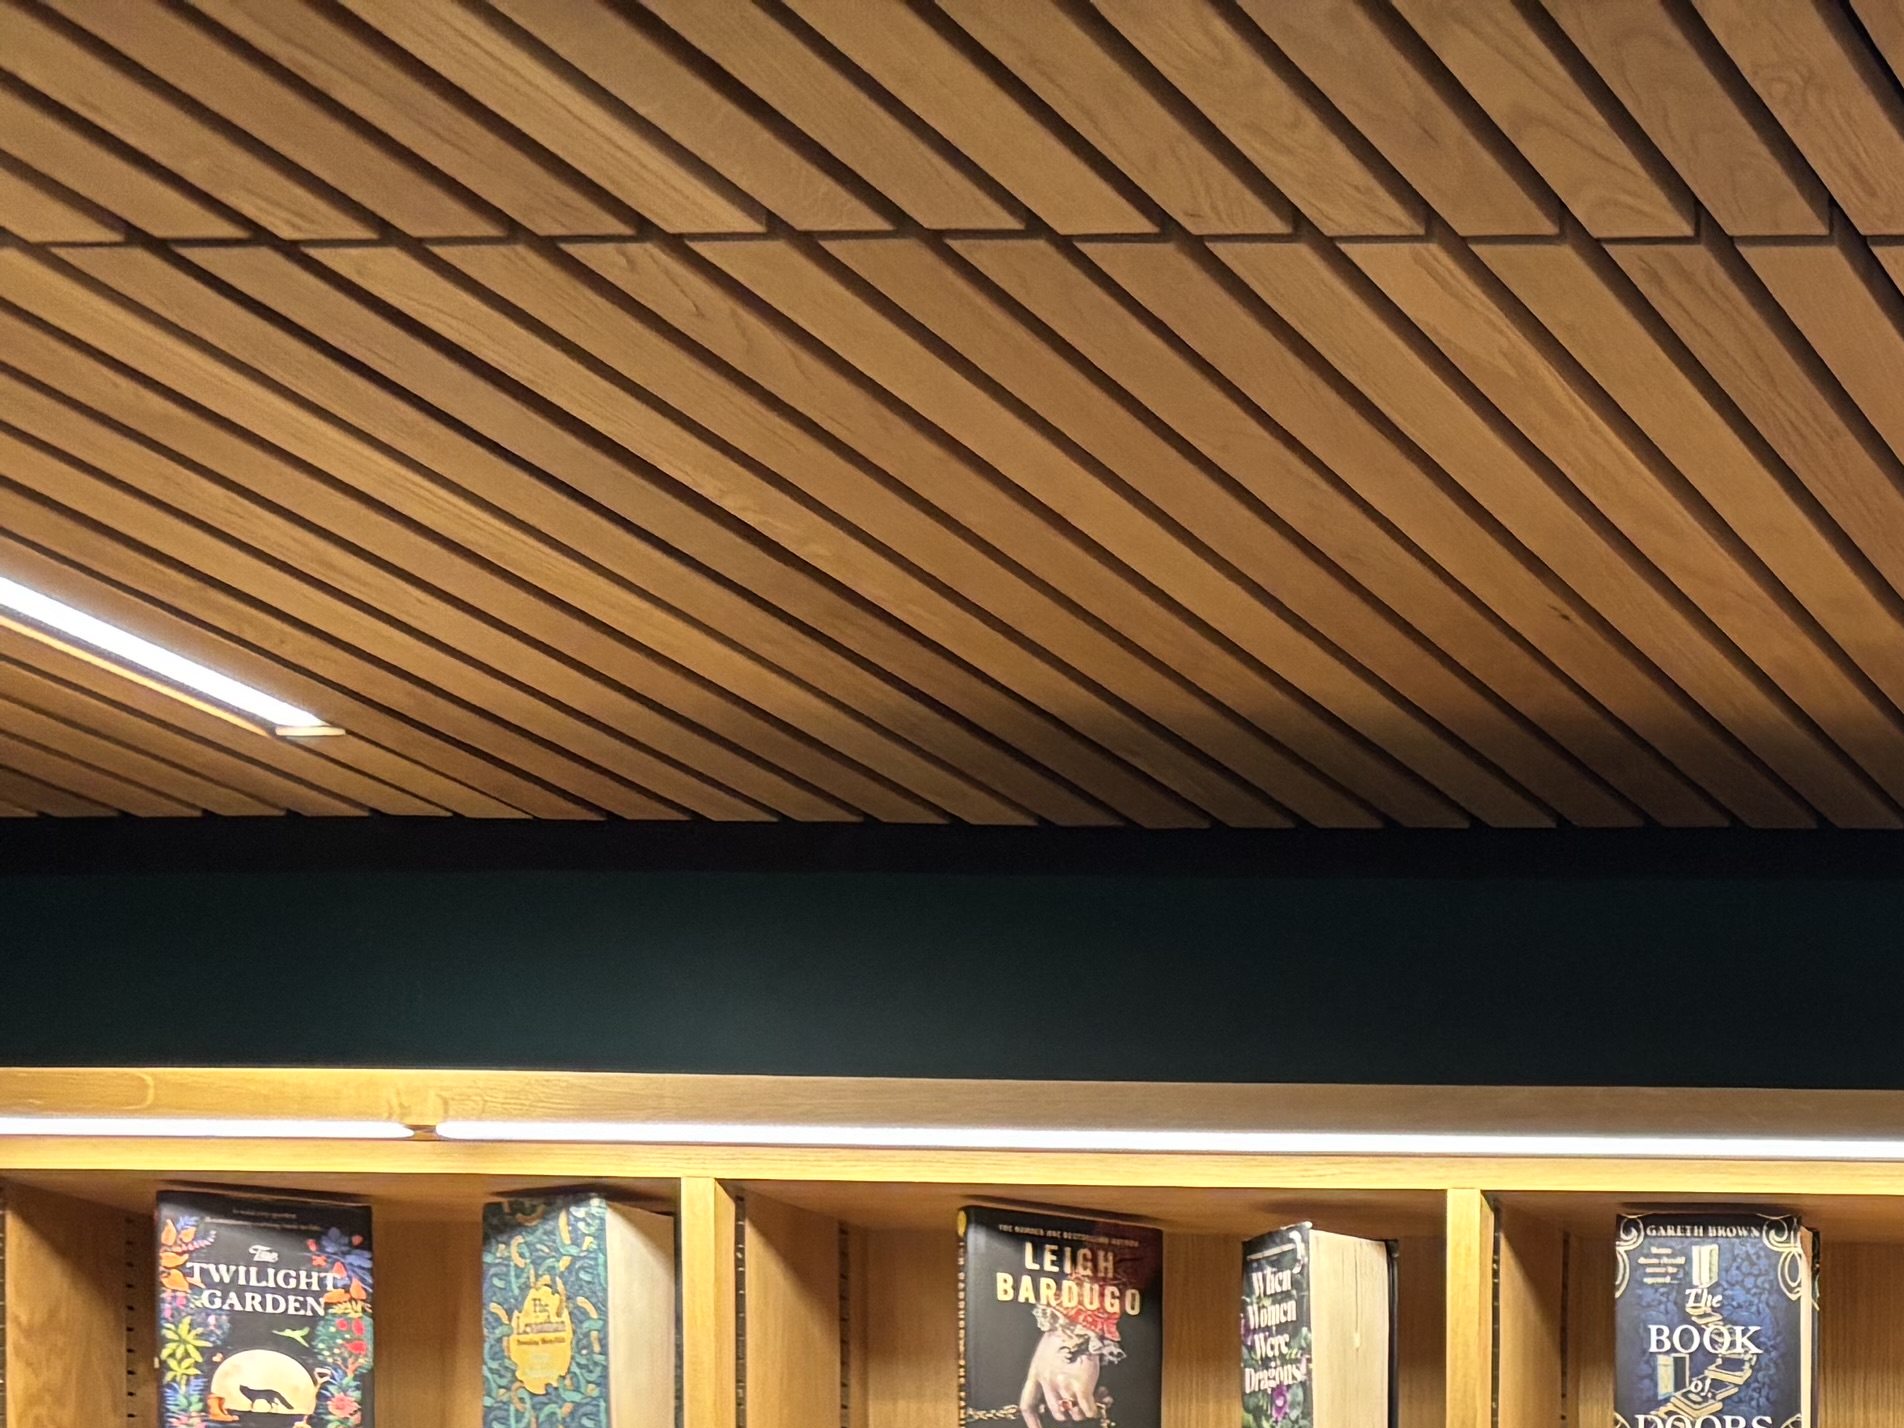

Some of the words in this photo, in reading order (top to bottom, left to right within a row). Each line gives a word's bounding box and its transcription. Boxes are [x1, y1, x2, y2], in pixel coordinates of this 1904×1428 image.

[1646, 1225, 1703, 1238] GARETH
[1708, 1225, 1761, 1238] BROWN
[1024, 1242, 1114, 1278] LEIGH
[186, 1262, 341, 1291] TWILIGHT
[1252, 1269, 1292, 1298] When
[201, 1289, 326, 1316] GARDEN
[996, 1272, 1141, 1316] BARDUGO
[1685, 1288, 1723, 1308] The
[1246, 1299, 1297, 1329] Women
[1254, 1331, 1290, 1359] Were
[1648, 1325, 1764, 1354] BOOK
[1244, 1362, 1302, 1395] Dragons
[1690, 1379, 1712, 1397] of
